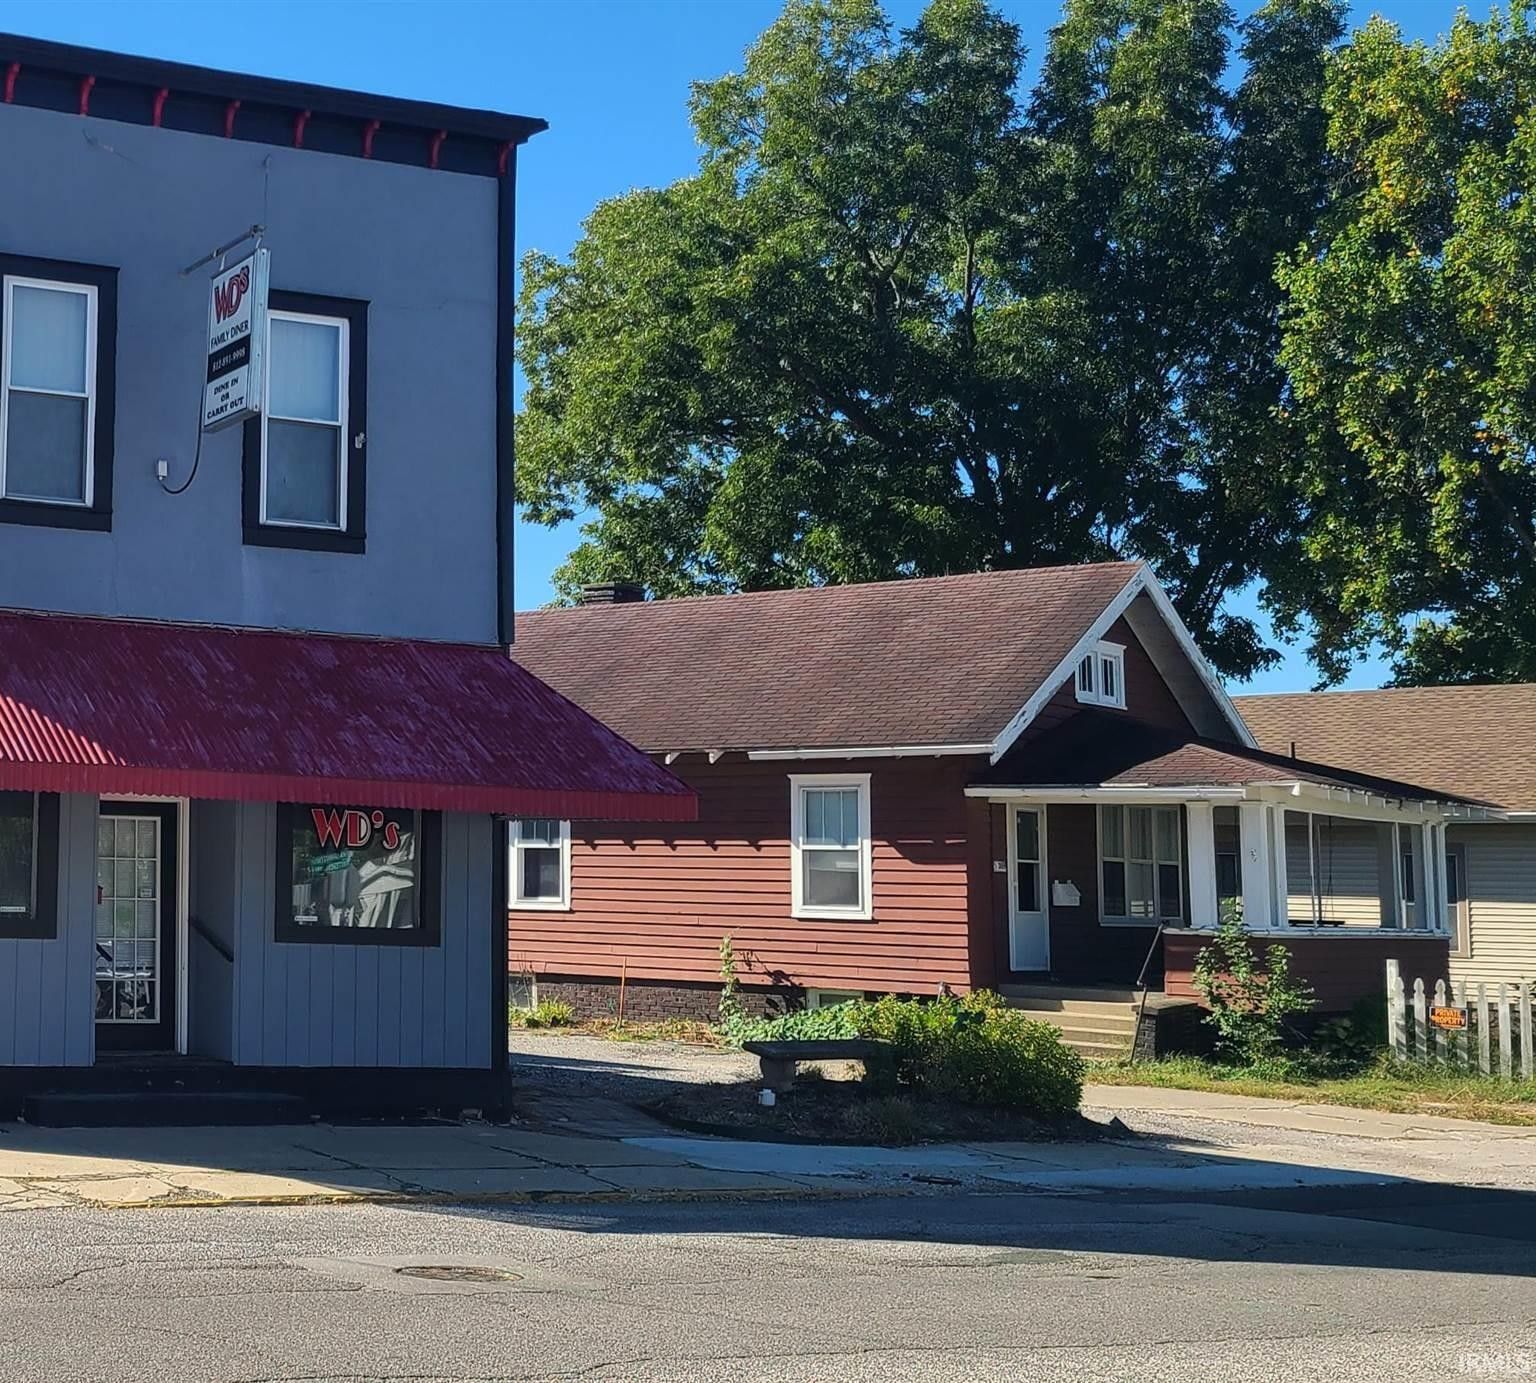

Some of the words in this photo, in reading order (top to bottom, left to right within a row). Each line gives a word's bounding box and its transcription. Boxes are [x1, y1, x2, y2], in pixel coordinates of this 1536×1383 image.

[211, 327, 230, 349] FAMILY
[230, 320, 249, 339] DINER
[214, 380, 230, 395] DINE
[230, 376, 239, 387] IN
[220, 392, 230, 402] OR
[207, 403, 229, 419] CARRY
[230, 396, 244, 409] OUT
[311, 808, 400, 849] WD's
[1431, 1016, 1465, 1025] PROPERTY
[1435, 1008, 1461, 1017] PRIVATE
